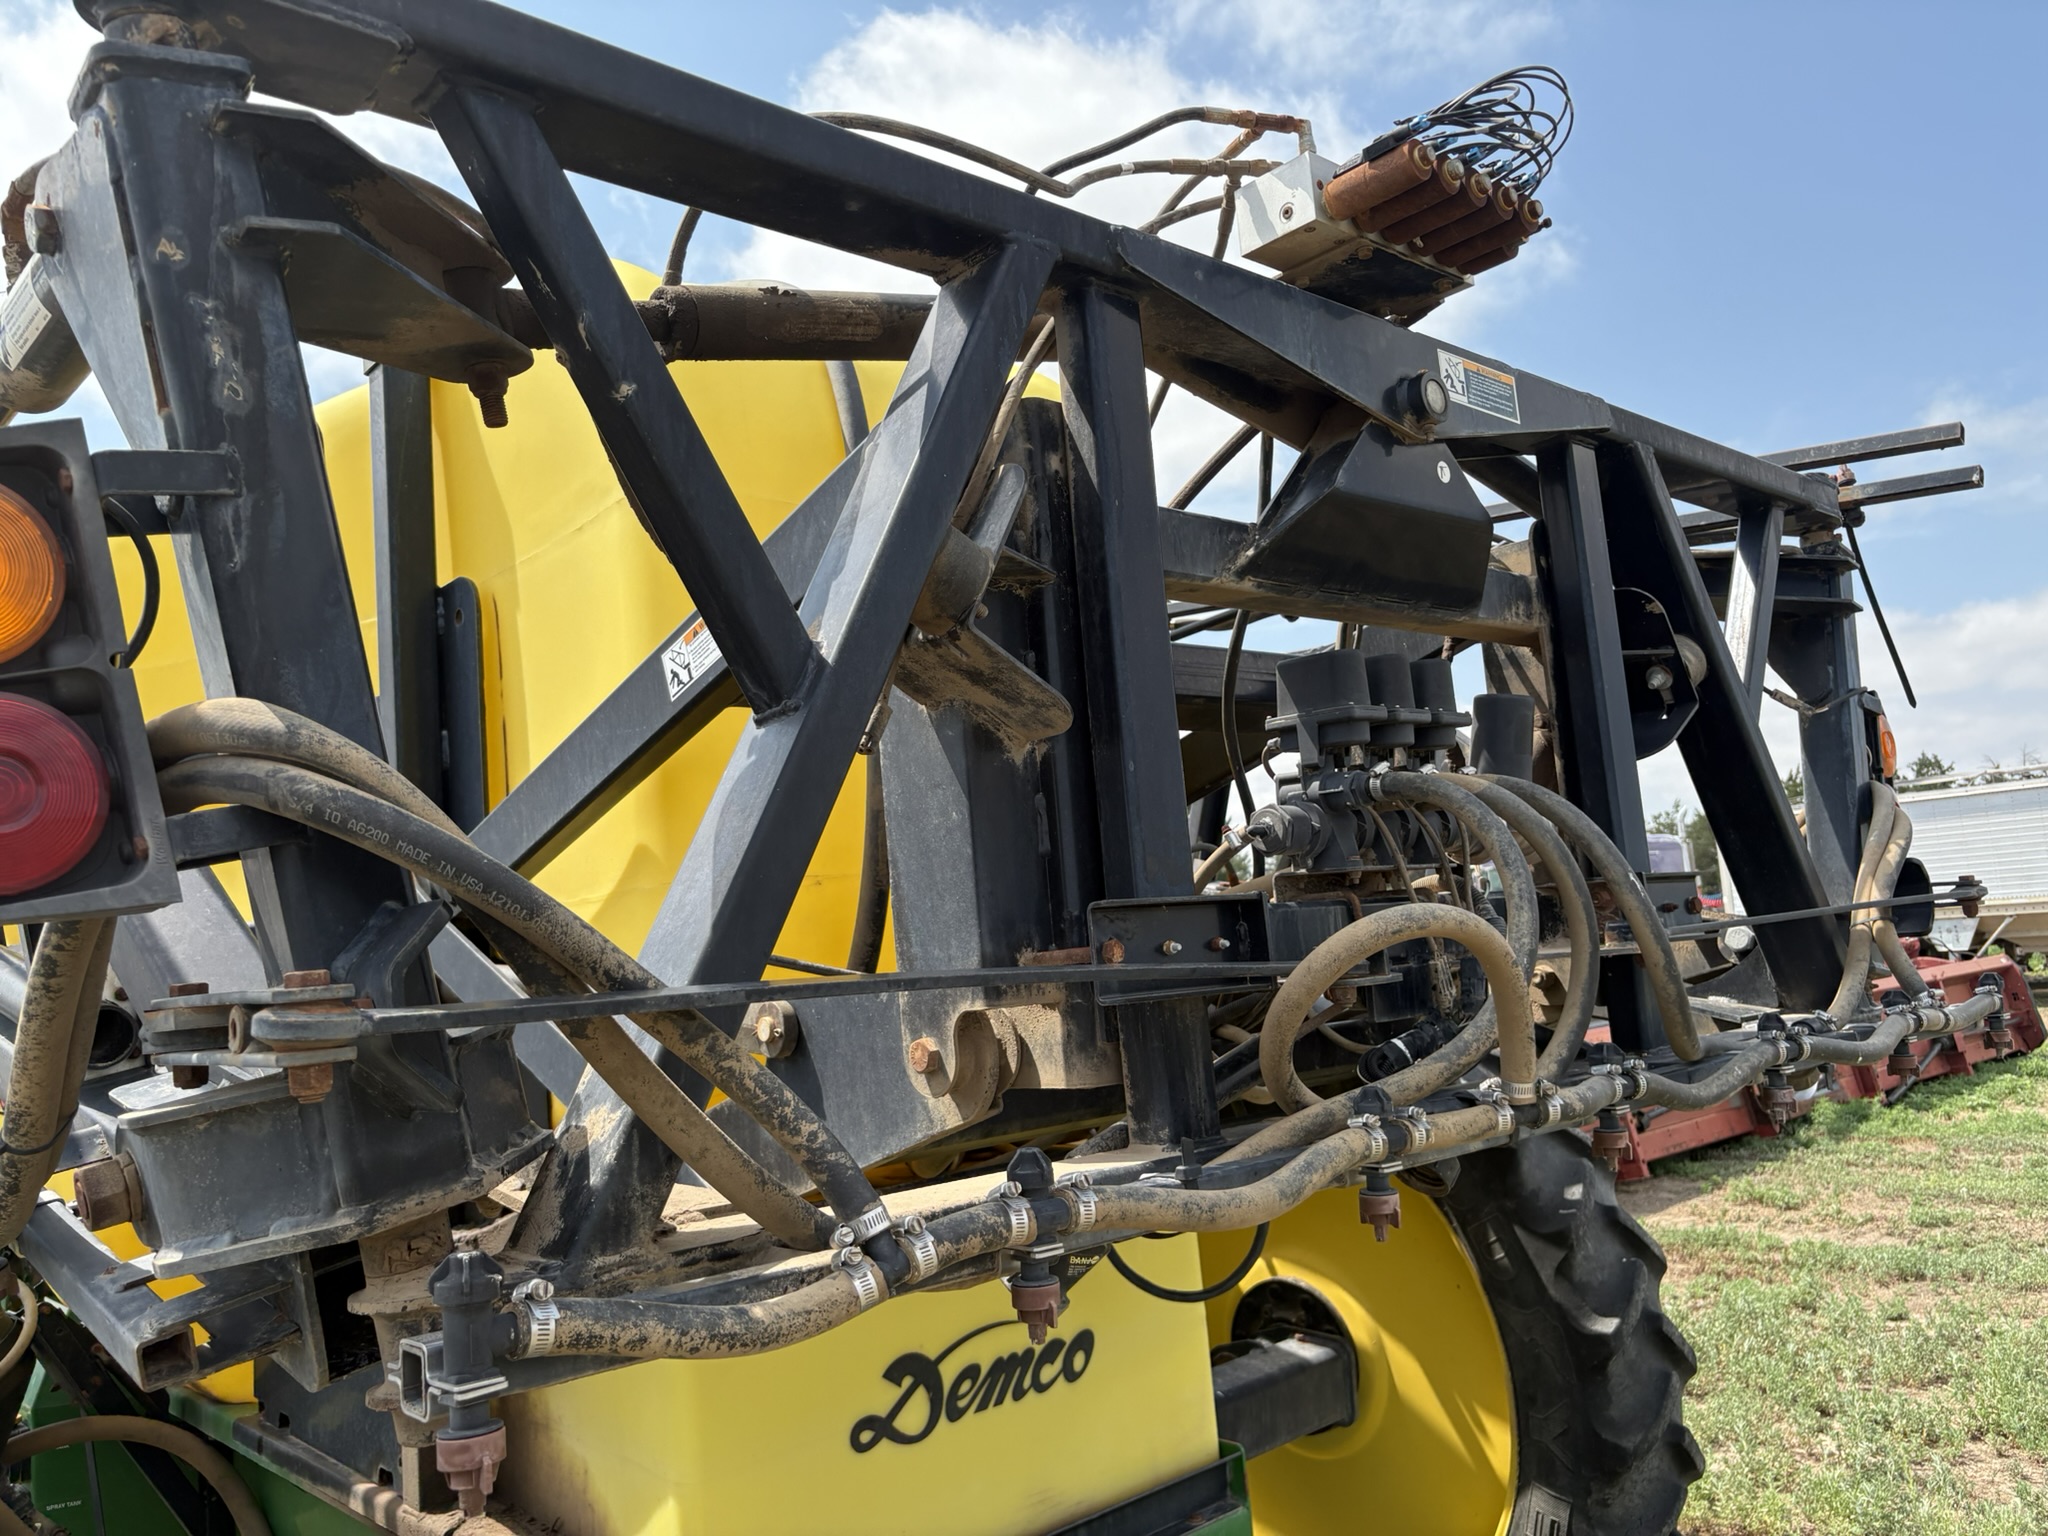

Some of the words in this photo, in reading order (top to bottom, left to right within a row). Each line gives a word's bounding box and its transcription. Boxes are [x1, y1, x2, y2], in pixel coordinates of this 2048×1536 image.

[347, 819, 390, 845] AG200
[396, 840, 432, 865] MADE
[436, 859, 457, 879] IN
[460, 872, 485, 893] USA
[850, 1320, 1095, 1453] Demco
[46, 1503, 65, 1511] SPRAY
